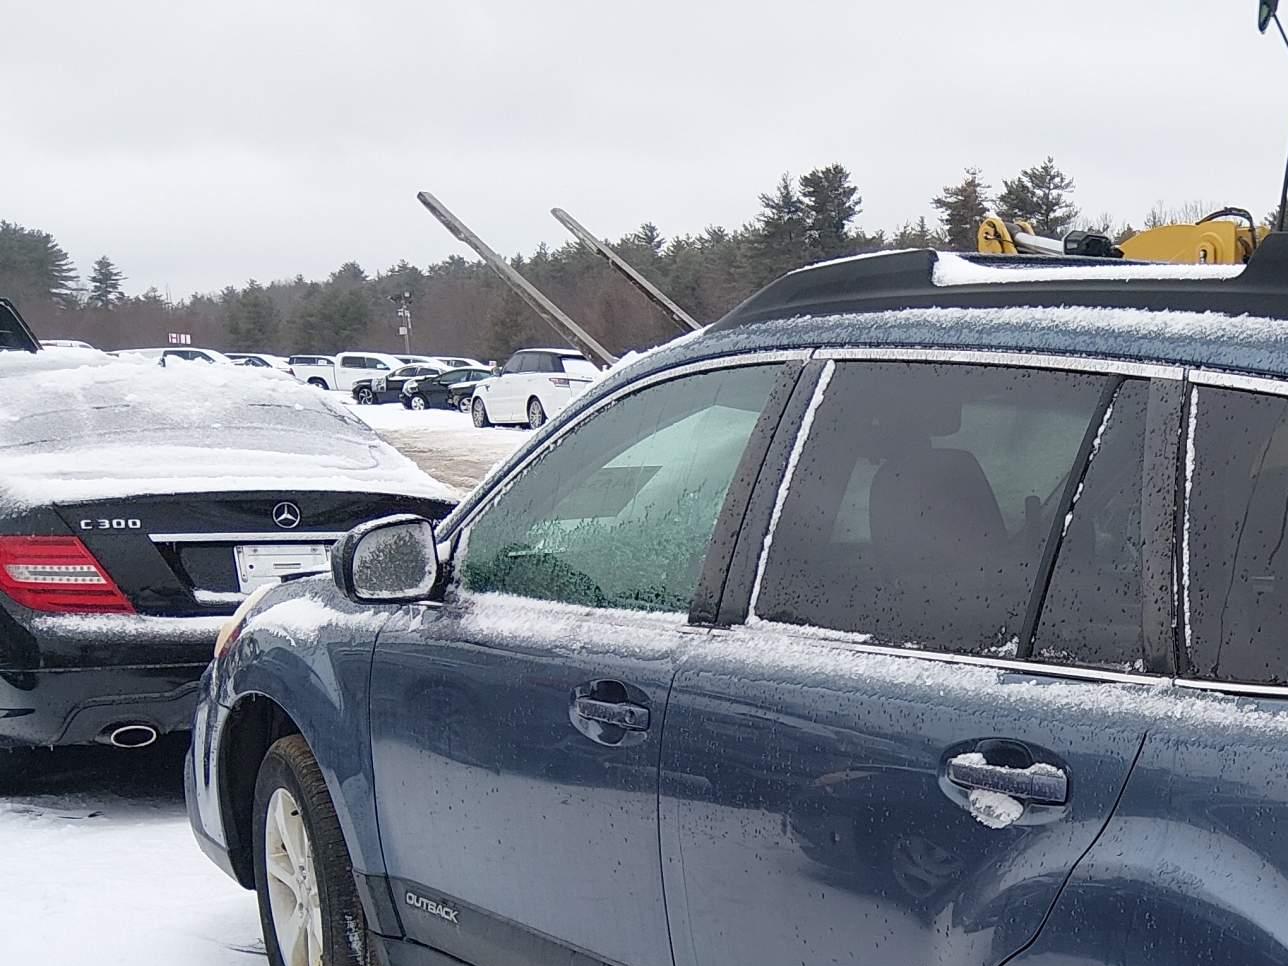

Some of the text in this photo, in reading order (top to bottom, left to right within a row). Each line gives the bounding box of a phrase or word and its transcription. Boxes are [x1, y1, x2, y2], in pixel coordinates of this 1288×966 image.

[80, 518, 141, 530] C 300
[406, 892, 459, 923] OUTBACK
